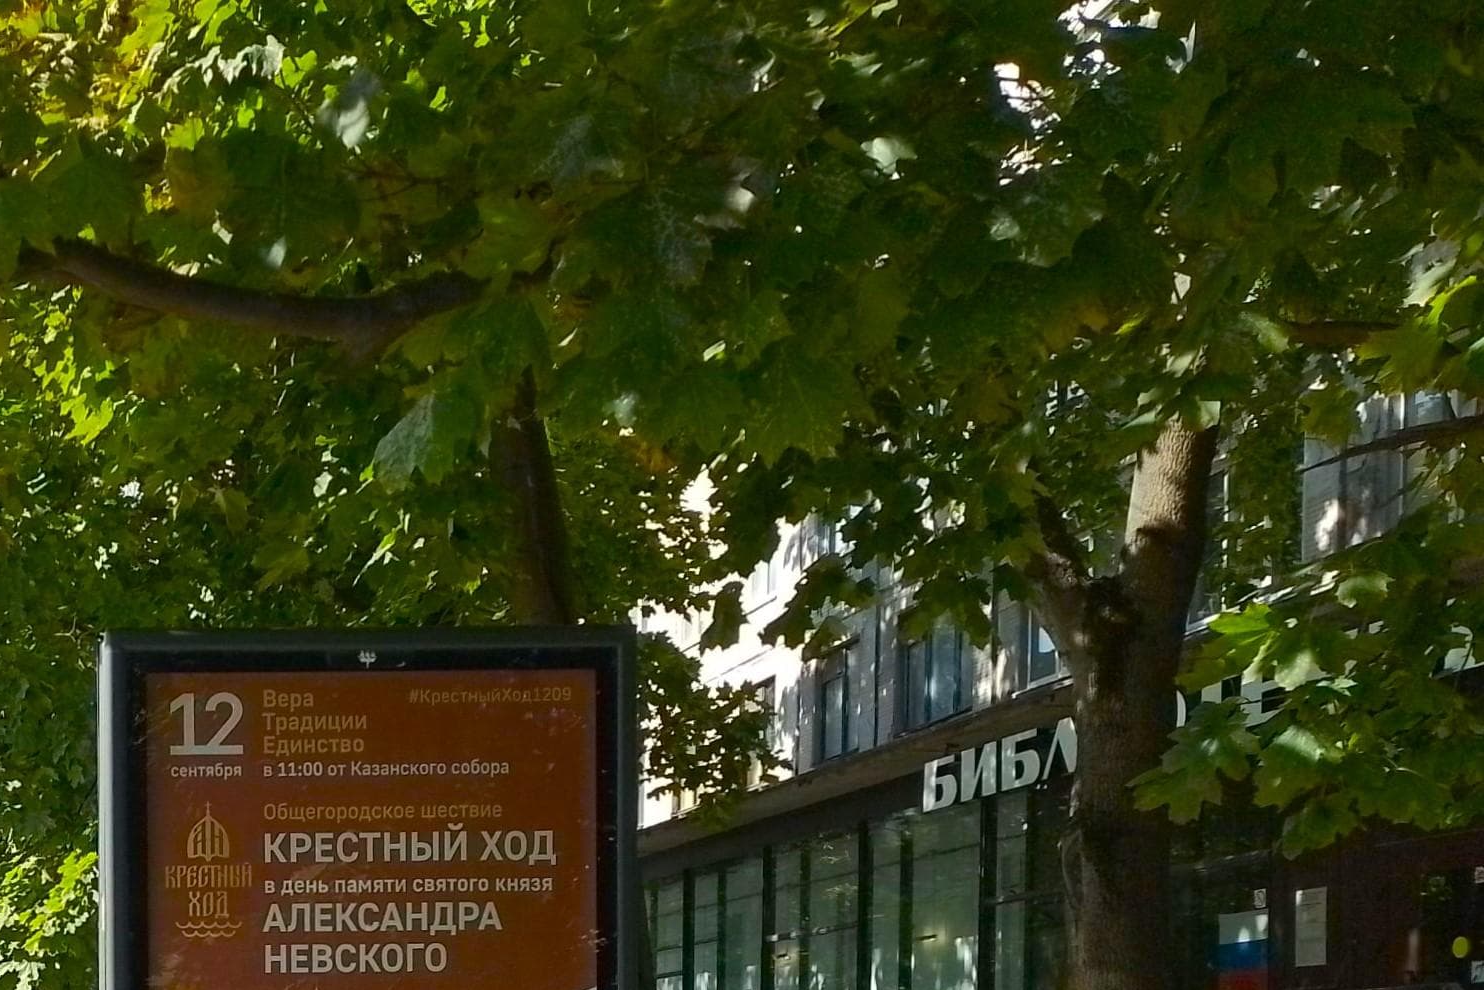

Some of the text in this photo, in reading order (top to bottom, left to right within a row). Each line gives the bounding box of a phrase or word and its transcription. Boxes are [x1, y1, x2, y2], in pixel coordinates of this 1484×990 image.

[263, 690, 314, 711] Вера
[409, 687, 572, 706] #КрестныйХод1209
[170, 692, 244, 755] 12
[262, 712, 367, 735] Традиции
[263, 736, 365, 756] Единство
[170, 762, 242, 780] сентября
[263, 758, 510, 778] в 11:00 от Казанского собора
[264, 803, 503, 823] Общегородское шествие
[264, 822, 557, 866] КРЕСТНЫЙ ХОД
[265, 877, 553, 895] в день памяти святого князя
[188, 891, 230, 919] ХОД
[262, 901, 503, 935] АЛЕКСАНДРА
[264, 943, 448, 974] НЕВСКОГО
